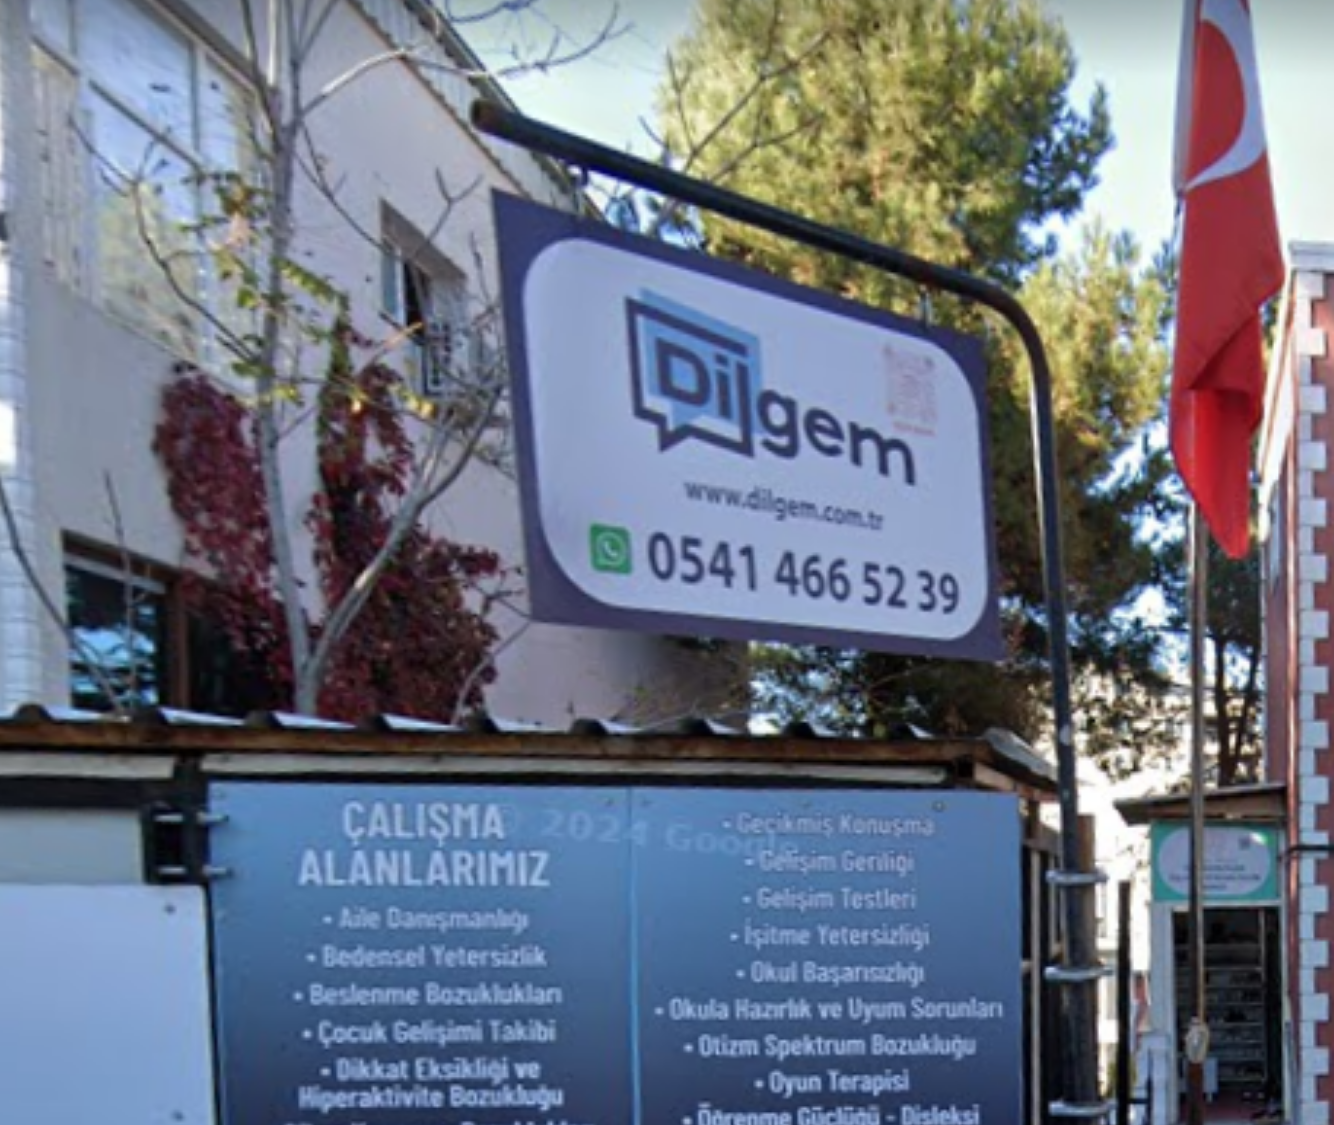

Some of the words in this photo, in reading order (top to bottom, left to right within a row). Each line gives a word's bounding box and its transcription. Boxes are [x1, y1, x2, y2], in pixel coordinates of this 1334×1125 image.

[654, 337, 917, 487] Dilgem
[684, 480, 884, 530] www.dilgem.com.tr
[647, 531, 758, 592] 0541
[774, 549, 851, 602] 466
[862, 562, 908, 609] 52
[918, 571, 961, 615] 39
[341, 802, 505, 847] ÇALIŞMA
[839, 813, 936, 839] Konuşma
[298, 849, 551, 887] ALANLARIMIZ
[759, 850, 837, 877] Gelişim
[841, 850, 916, 878] Geriliği
[756, 887, 835, 914] Gelişim
[841, 887, 917, 911] Testleri
[339, 906, 380, 929] Aile
[386, 906, 529, 935] Danışmanlığı
[743, 918, 811, 950] İşitme
[817, 923, 931, 952] Yetersizliği
[322, 944, 425, 968] Bedensel
[432, 945, 547, 968] Yetersizlik
[750, 961, 797, 984] Okul
[802, 960, 926, 988] Başarısızlığı
[310, 983, 419, 1005] Beslenme
[425, 981, 563, 1005] Bozuklukları
[669, 998, 730, 1021] Okula
[735, 998, 813, 1021] Hazırlık
[818, 1003, 843, 1020] ve
[848, 998, 907, 1025] Uyum
[911, 996, 1004, 1019] Sorunları
[318, 1020, 387, 1049] Çocuk
[393, 1019, 483, 1047] Gelişimi
[489, 1018, 557, 1043] Takibi
[697, 1033, 760, 1057] Otizm
[765, 1034, 867, 1061] Spektrum
[871, 1033, 977, 1061] Bozukluğu
[336, 1057, 409, 1082] Dikkat
[416, 1056, 509, 1086] Eksikliği
[515, 1062, 542, 1080] ve
[769, 1070, 822, 1098] Oyun
[827, 1068, 911, 1096] Terapisi
[298, 1084, 444, 1114] Hiperaktivite
[449, 1084, 565, 1112] Bozukluğu
